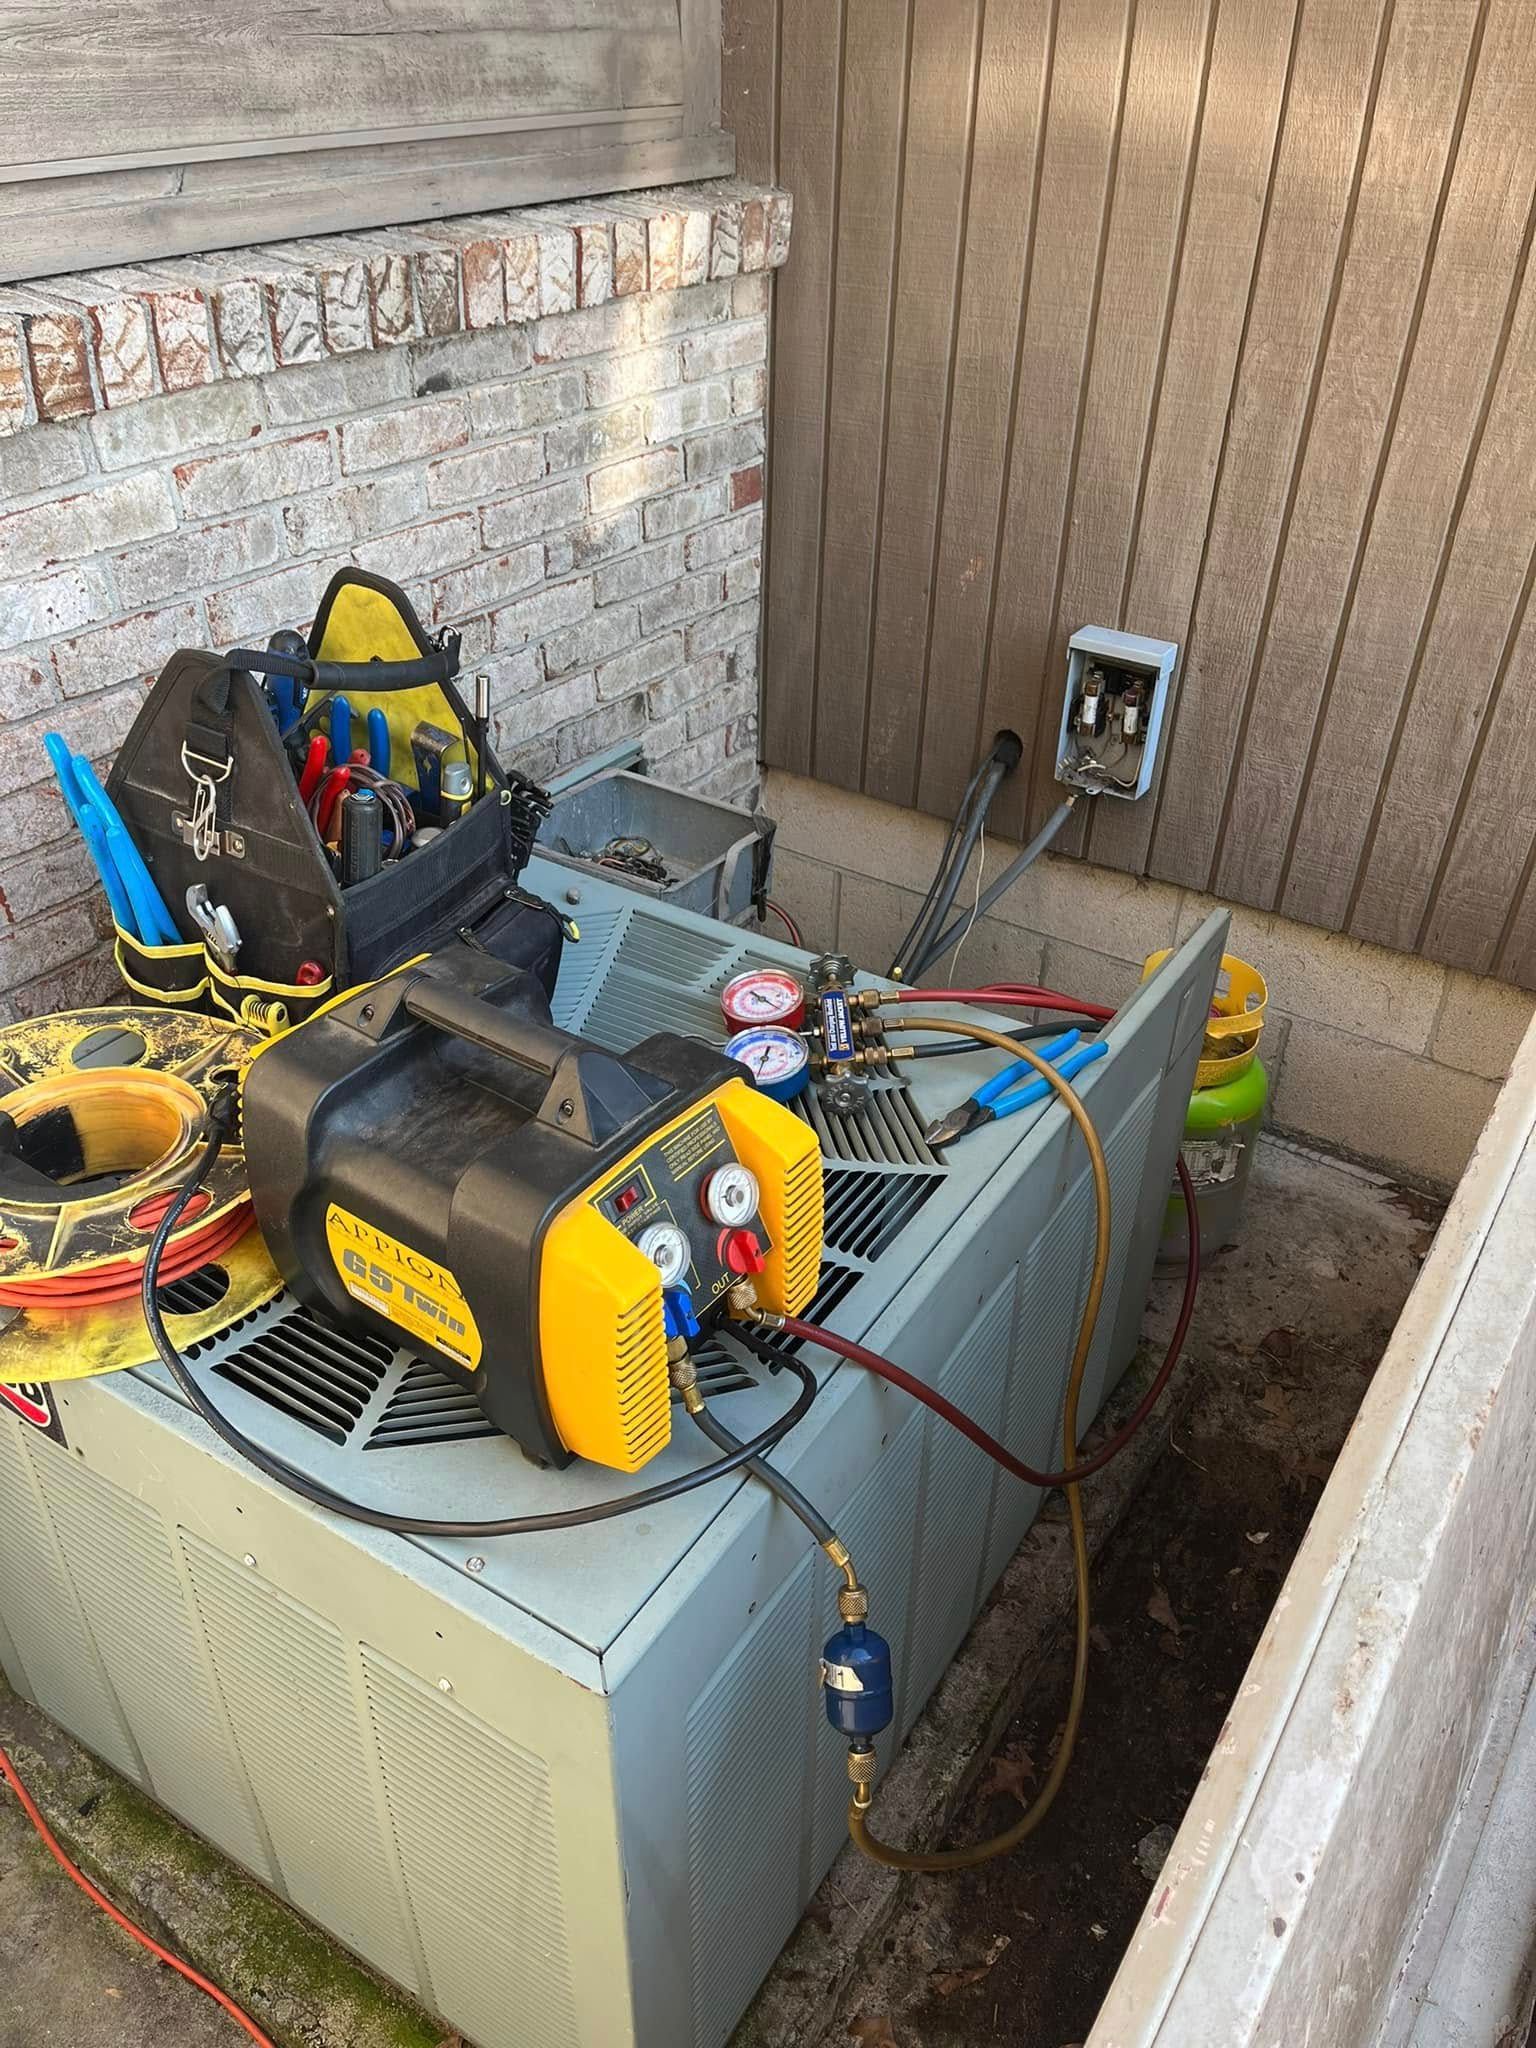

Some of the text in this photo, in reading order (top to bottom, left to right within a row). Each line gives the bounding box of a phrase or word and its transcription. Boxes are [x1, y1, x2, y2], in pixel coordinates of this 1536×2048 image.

[836, 999, 847, 1043] YELLOW JACKET
[621, 1205, 643, 1225] POWER
[328, 1212, 465, 1300] APPION
[711, 1271, 730, 1295] OUT
